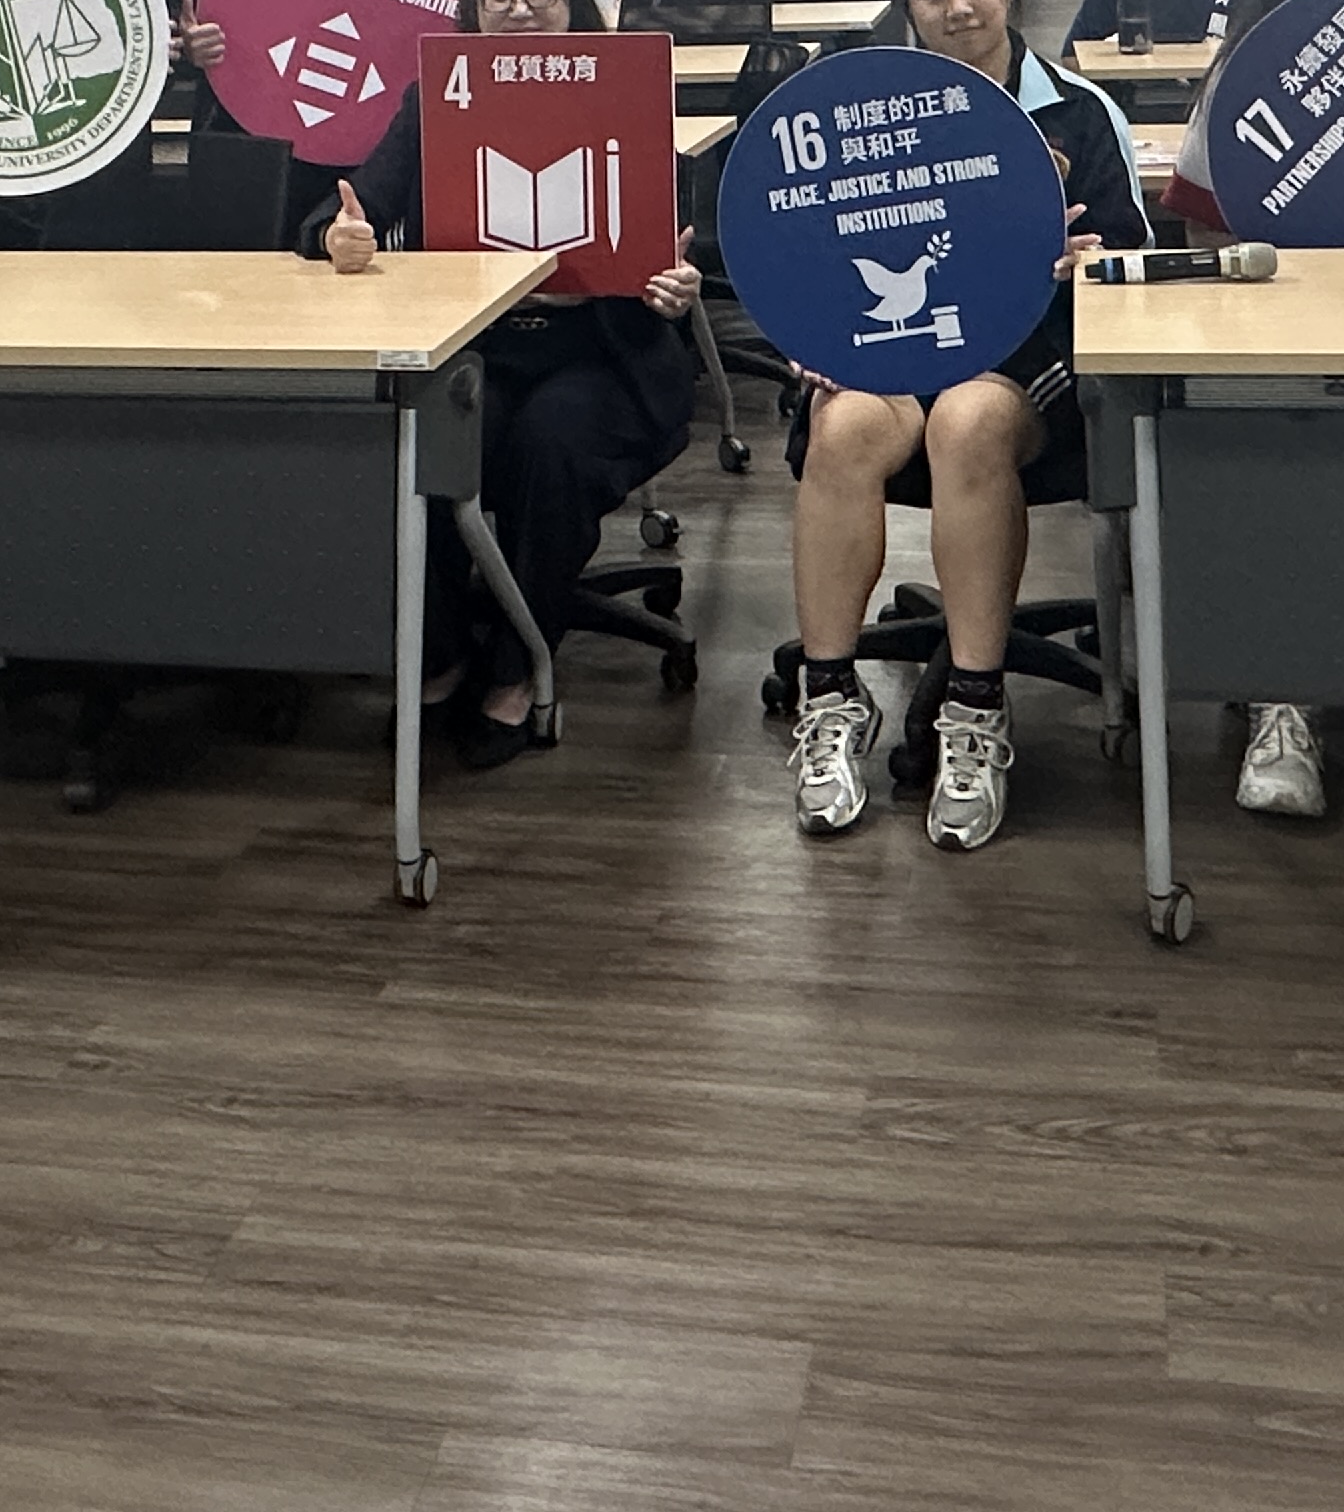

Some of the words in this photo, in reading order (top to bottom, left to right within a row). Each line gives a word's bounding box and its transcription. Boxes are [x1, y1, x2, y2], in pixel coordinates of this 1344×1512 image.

[87, 49, 143, 138] DEPARTMENT
[131, 25, 145, 44] OF
[444, 54, 472, 110] 4
[491, 54, 598, 82] 優質教育
[46, 117, 79, 141] 1996
[833, 85, 971, 132] 制度的正義
[1235, 98, 1295, 162] 17
[771, 112, 827, 175] 16
[840, 127, 922, 165] 與和平
[828, 172, 893, 202] JUSTICE
[896, 165, 931, 190] AND
[933, 154, 1000, 185] STRONG
[836, 198, 947, 236] INSTITUTIONS
